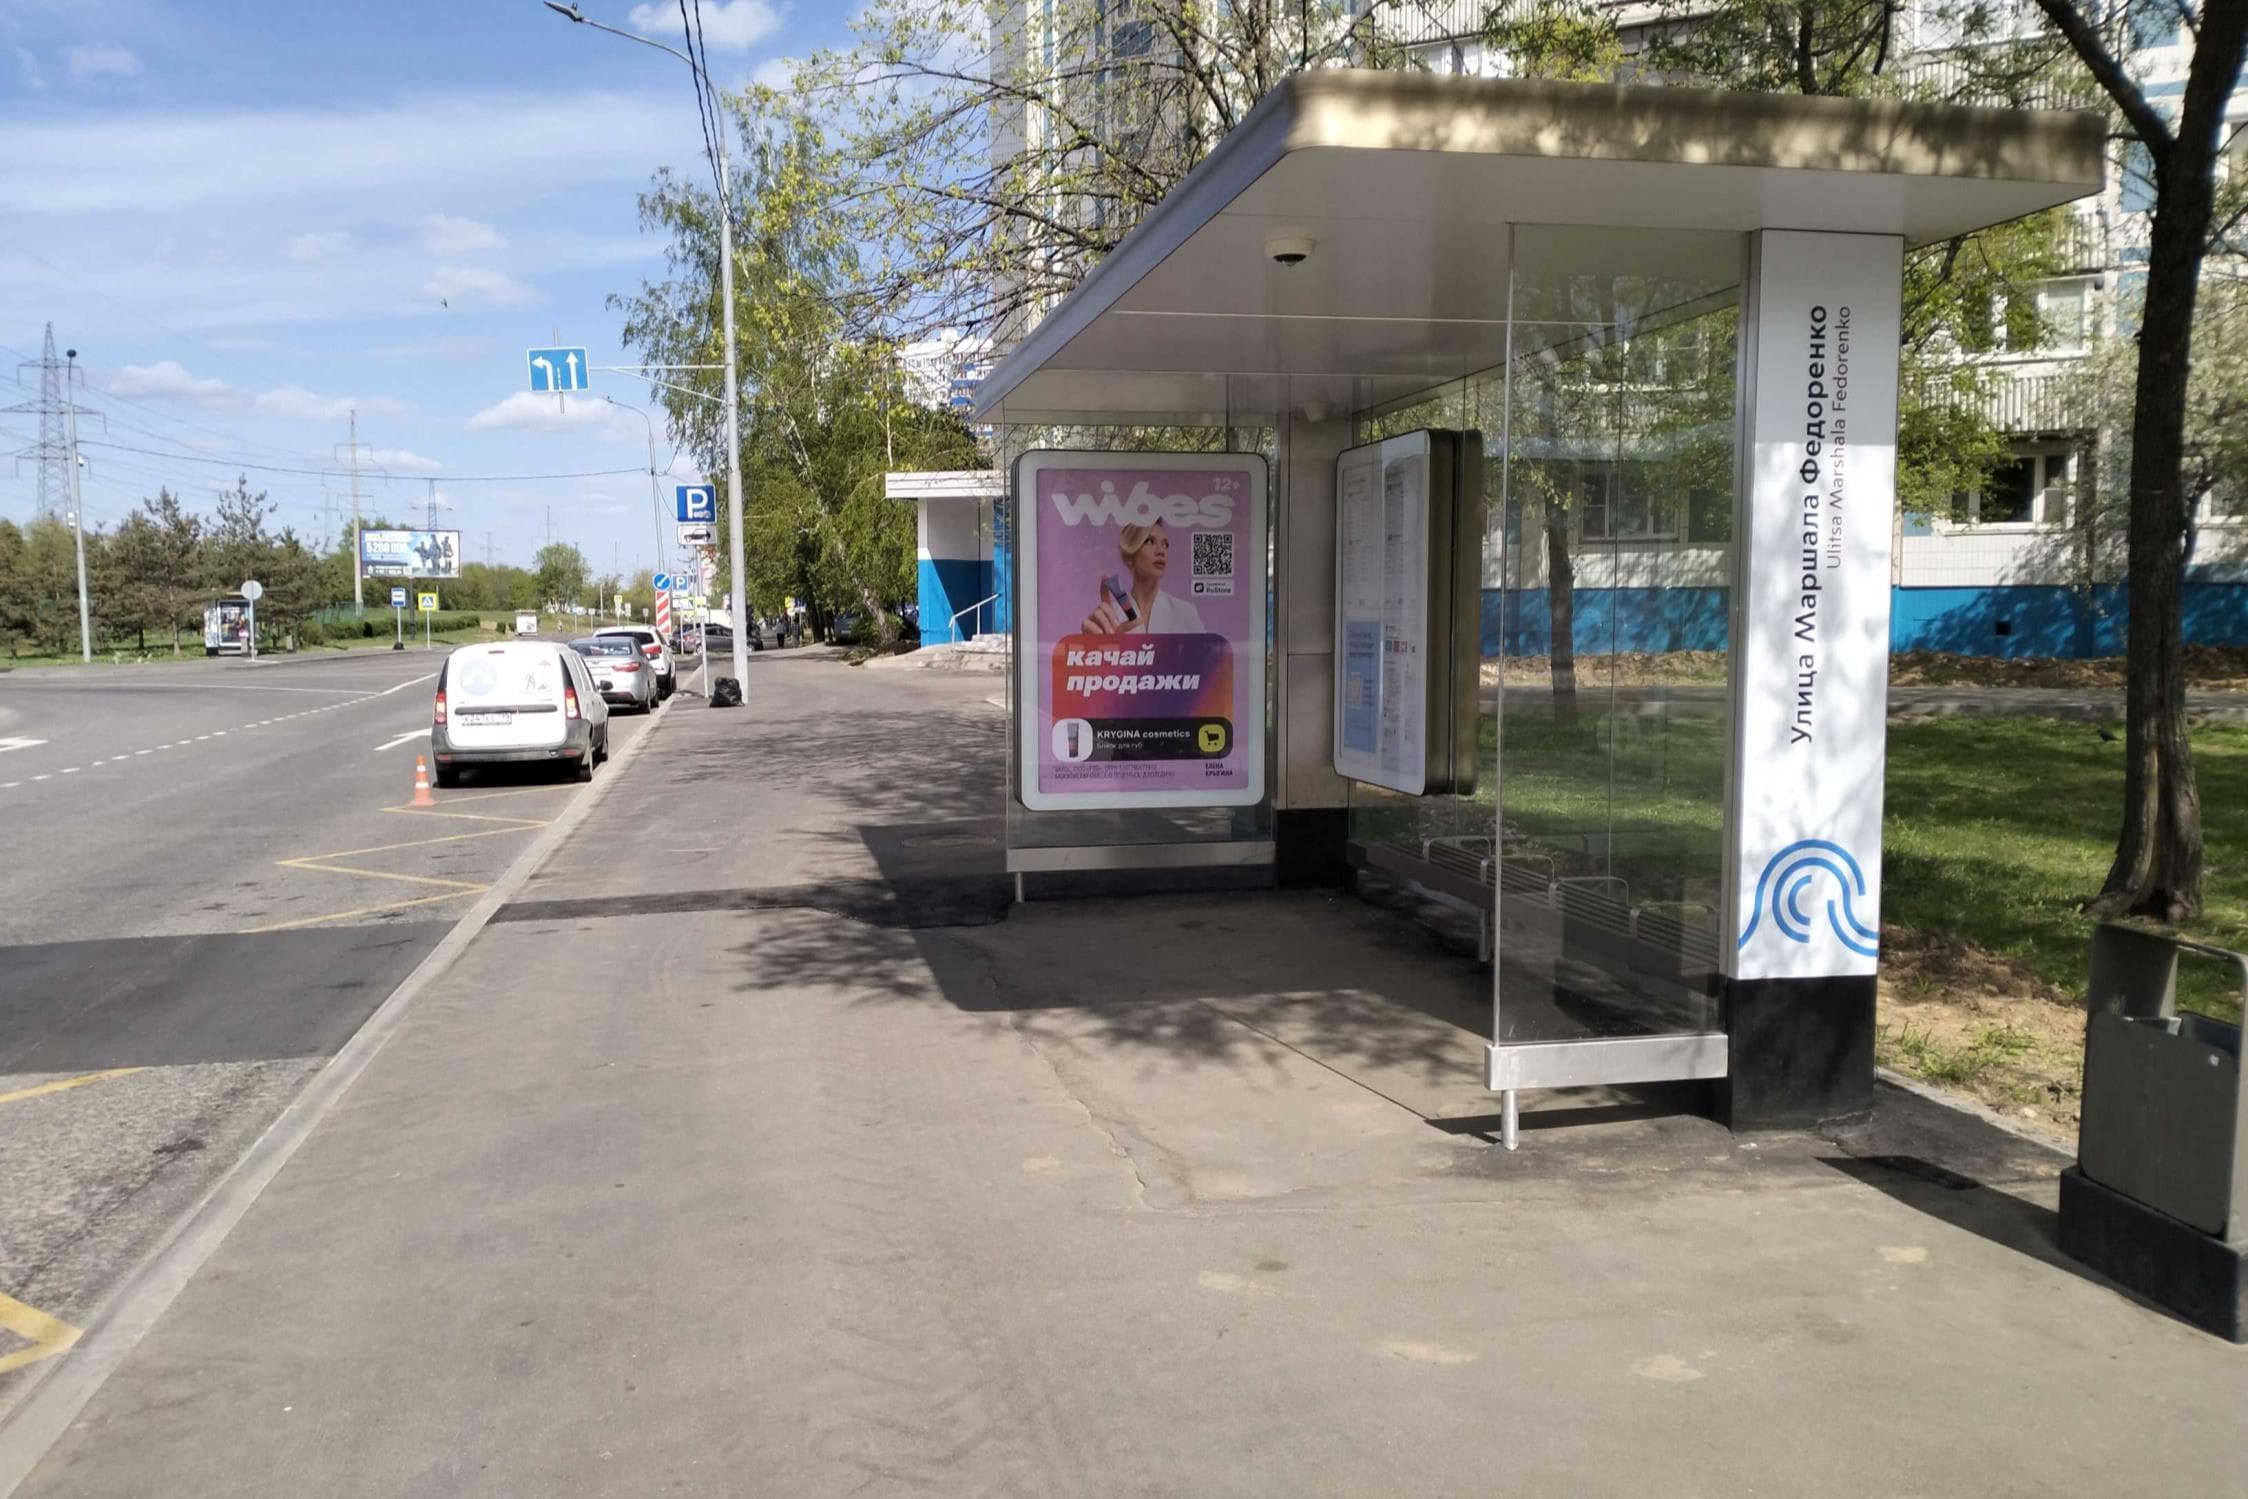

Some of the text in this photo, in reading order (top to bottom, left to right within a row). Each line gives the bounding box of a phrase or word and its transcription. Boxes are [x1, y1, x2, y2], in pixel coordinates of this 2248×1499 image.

[1827, 306, 1851, 569] Ulitsa Marshala Fedorenko
[1213, 478, 1240, 492] 12+
[686, 488, 709, 519] P
[1791, 305, 1829, 744] Улица Маршала Федоренко
[1066, 674, 1200, 697] продажи
[1097, 729, 1190, 739] KRYGINA cosmetics
